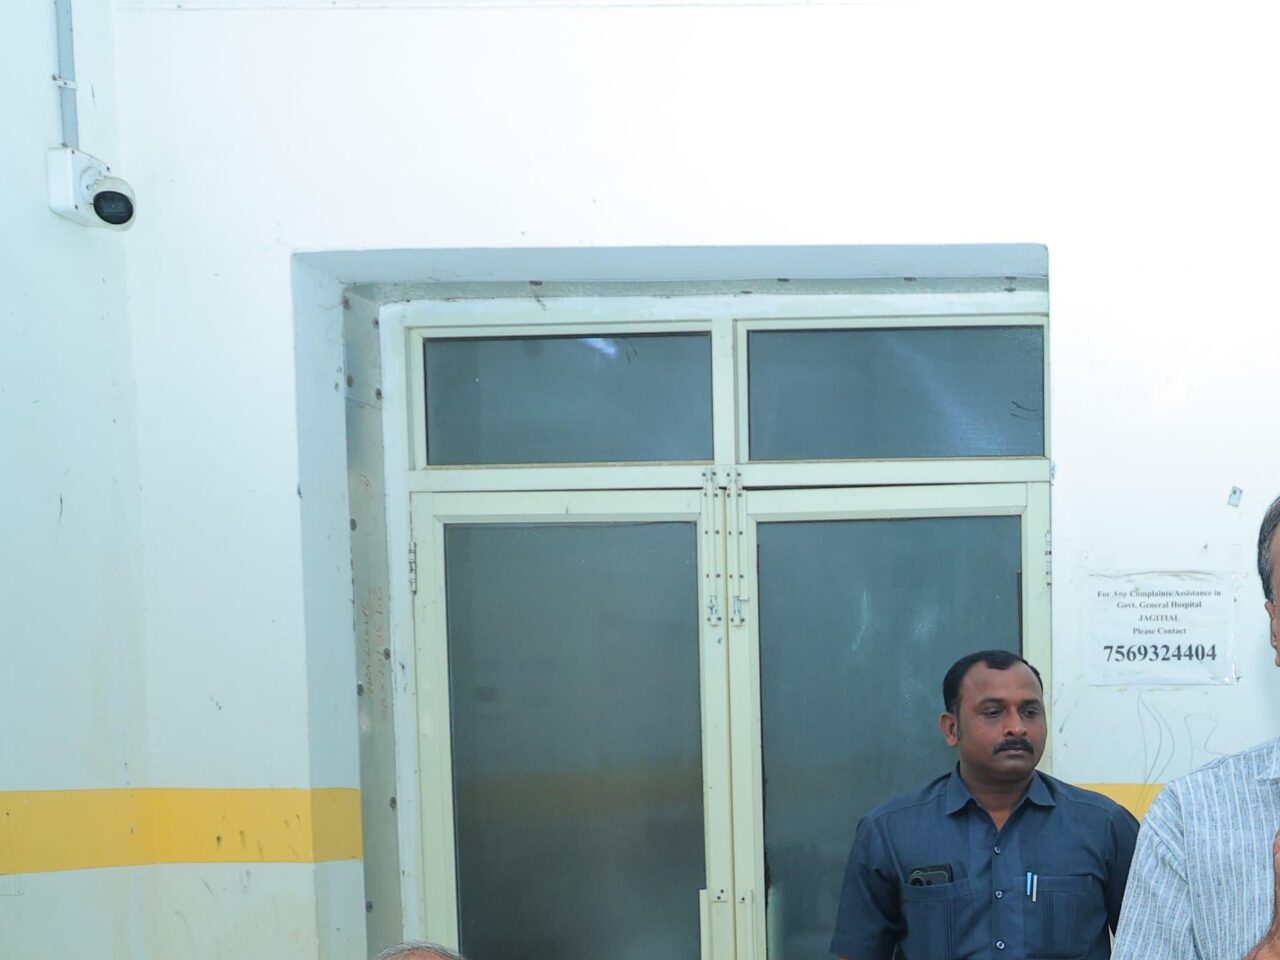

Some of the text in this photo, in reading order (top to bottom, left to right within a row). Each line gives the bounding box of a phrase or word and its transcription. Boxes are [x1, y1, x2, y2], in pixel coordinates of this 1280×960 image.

[1113, 590, 1127, 599] Any
[1139, 601, 1169, 609] General
[1171, 600, 1202, 610] Hospital
[1132, 627, 1187, 635] Please Contact
[1103, 643, 1217, 662] 7569324404
